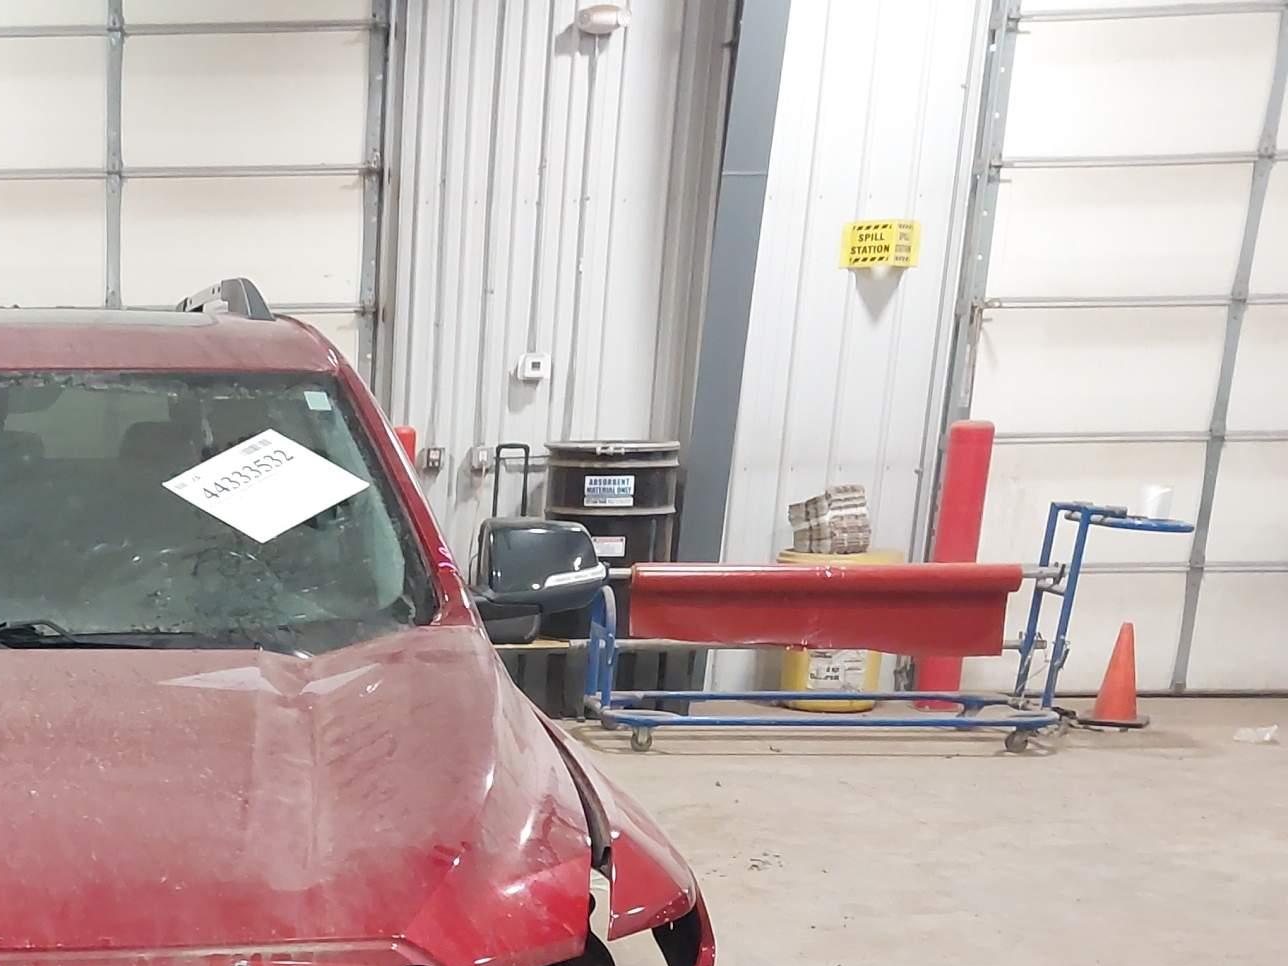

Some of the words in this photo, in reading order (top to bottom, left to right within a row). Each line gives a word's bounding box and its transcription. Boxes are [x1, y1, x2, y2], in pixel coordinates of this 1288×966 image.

[858, 232, 885, 242] SPILL
[850, 244, 890, 255] STATION
[203, 449, 294, 500] 44333532
